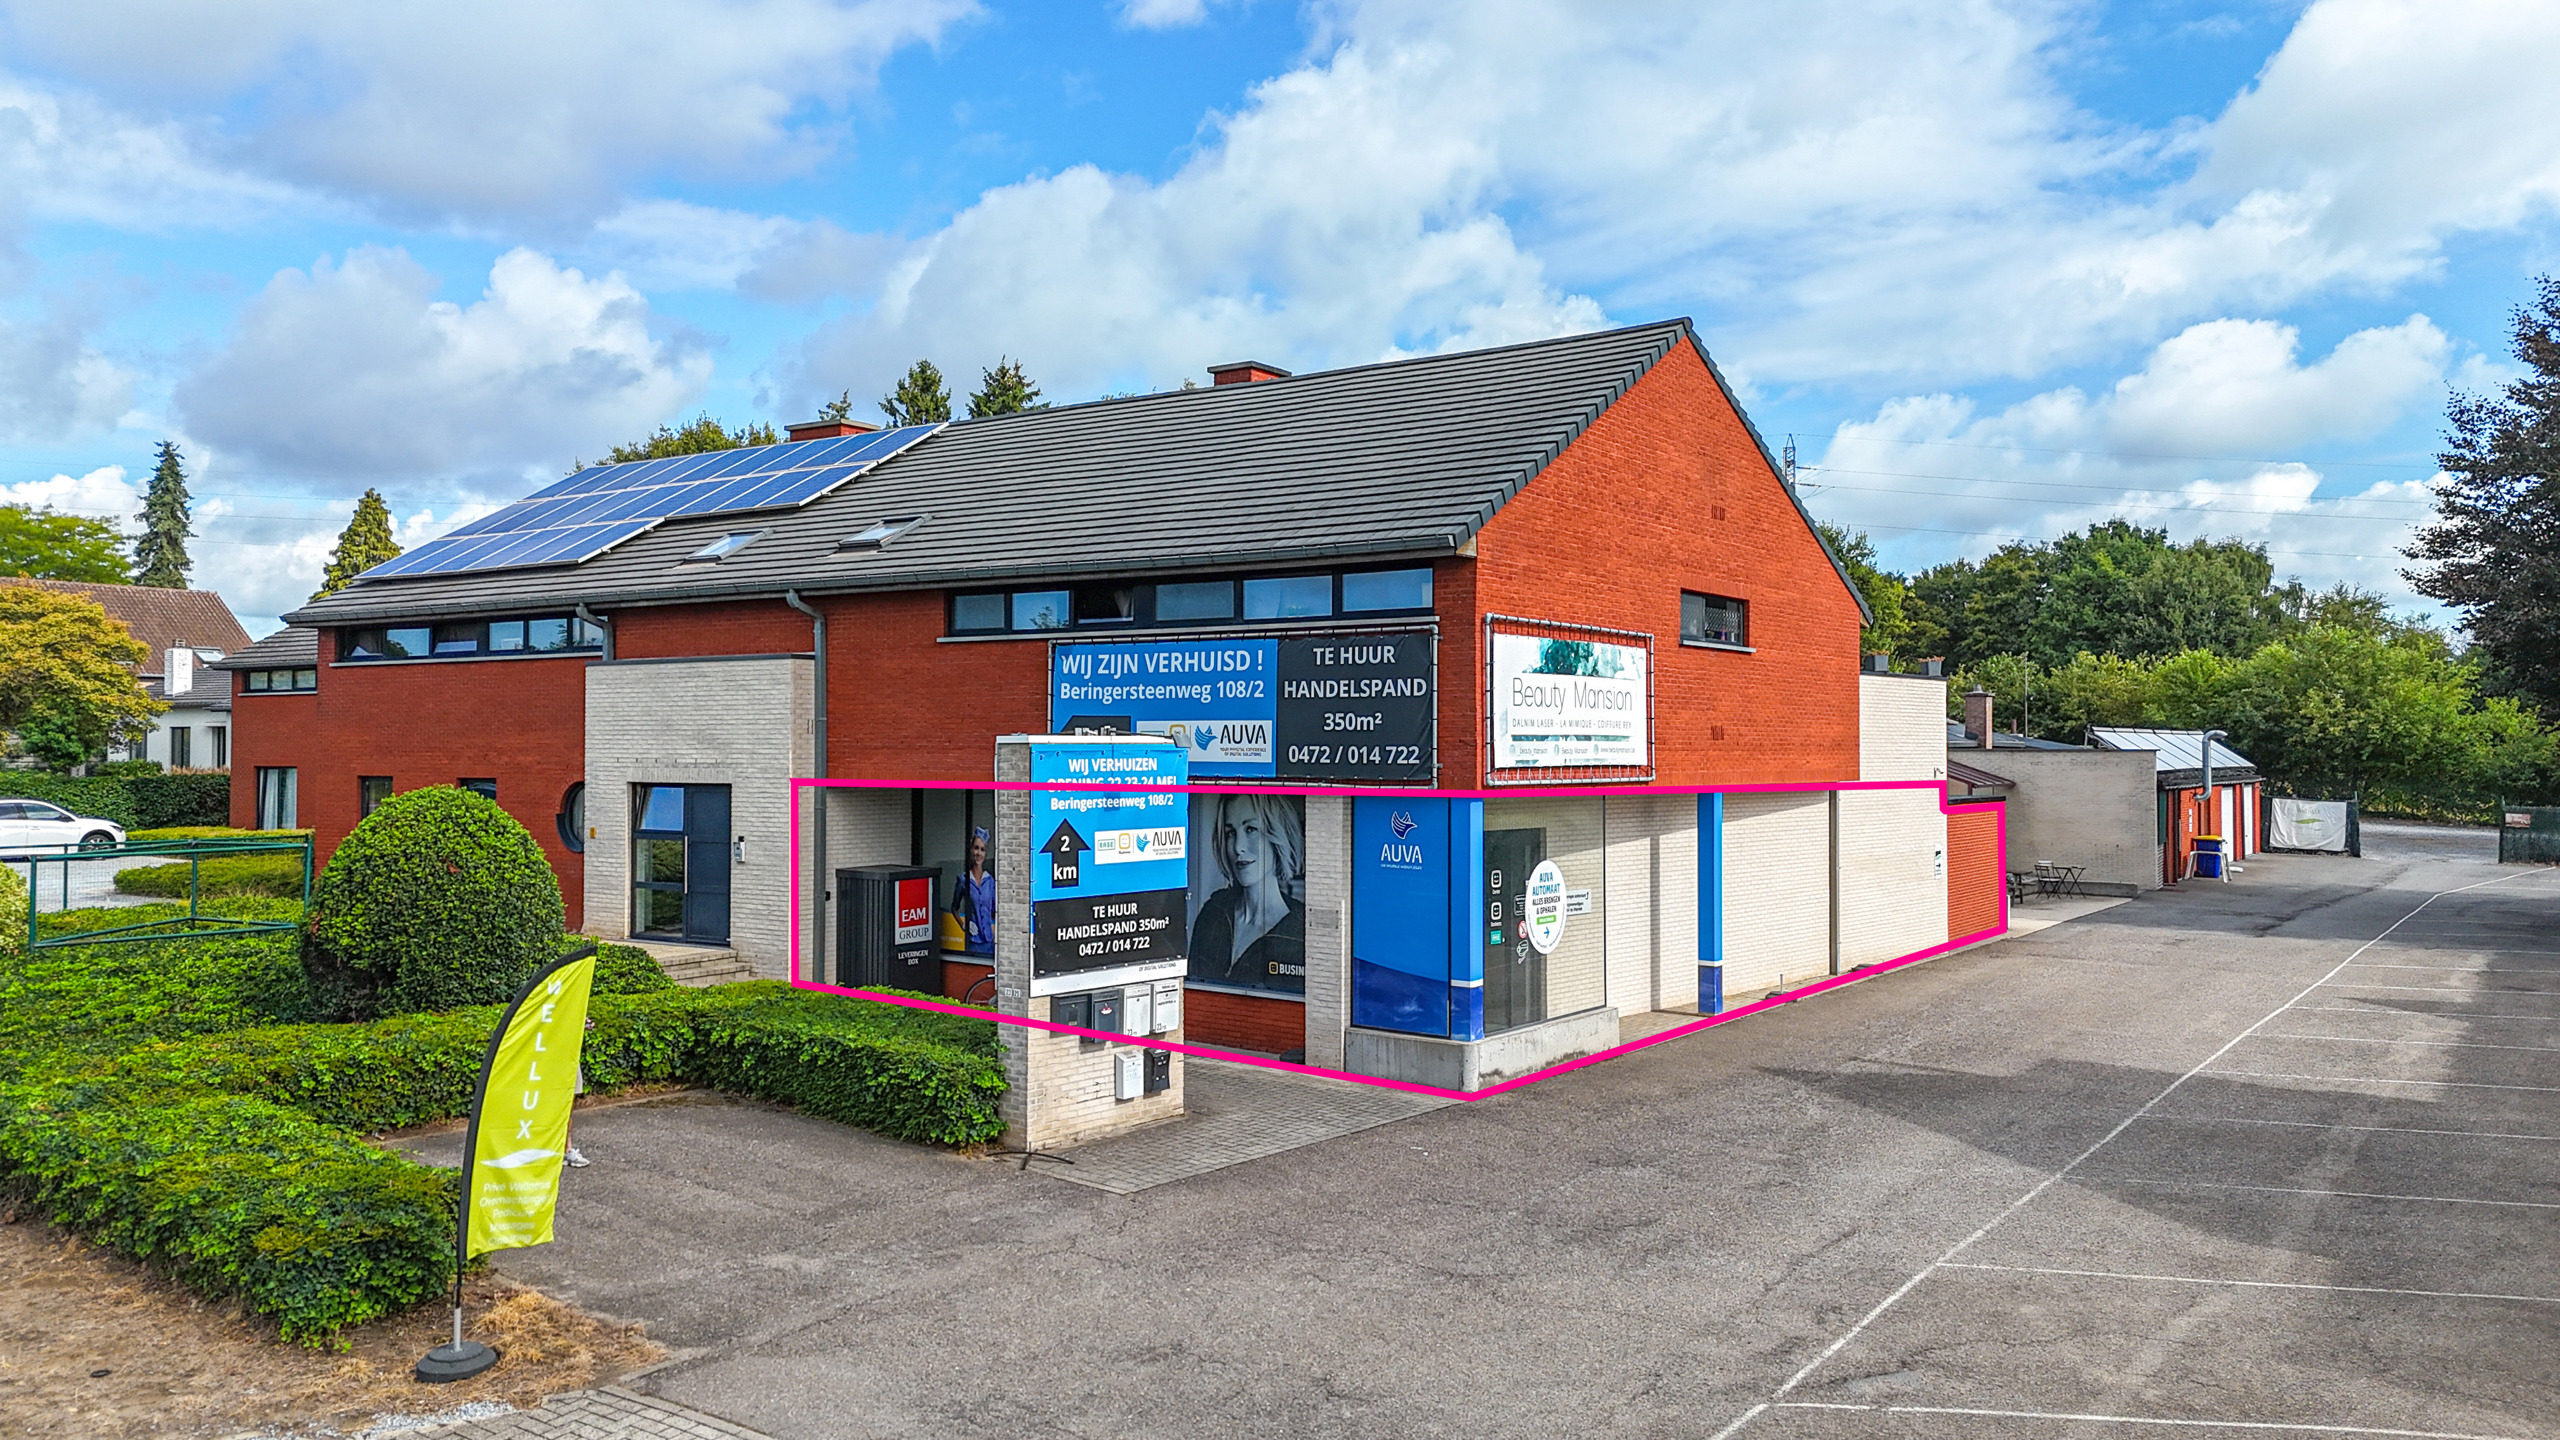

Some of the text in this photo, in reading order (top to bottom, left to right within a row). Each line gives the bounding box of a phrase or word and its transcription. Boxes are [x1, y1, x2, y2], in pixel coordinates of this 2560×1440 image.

[1313, 646, 1396, 665] TE HUUR
[1061, 650, 1263, 679] WIJ ZIJN VERHUISD !
[1060, 680, 1264, 705] Beringersteenweg 108/2
[1284, 678, 1427, 698] HANDELSPAND
[1512, 677, 1632, 715] Beauty Mansion
[1536, 718, 1554, 728] LASER
[1560, 719, 1567, 728] LA
[1568, 719, 1592, 728] MIMIQUE
[1597, 719, 1622, 729] COIFFURE
[1220, 724, 1267, 744] AUVA
[1288, 745, 1420, 764] 0472 / 014 722
[1068, 758, 1157, 775] WIJ VERHUIZEN
[1050, 794, 1174, 812] Beringersteenweg 108/2
[1060, 835, 1070, 851] 2
[1152, 830, 1182, 846] AUVA
[1381, 843, 1422, 864] AUVA
[1053, 863, 1077, 880] km
[1539, 872, 1554, 883] AUVA
[1532, 883, 1561, 896] AUTOMAAT
[1532, 897, 1544, 906] ALLES
[1543, 895, 1561, 905] BRENGEN
[902, 907, 926, 922] EAM
[1093, 903, 1138, 919] TE HUUR
[1540, 905, 1557, 914] OPHALEN
[899, 928, 929, 940] GROUP
[1057, 920, 1137, 940] HANDELSPAND
[898, 949, 929, 959] LEVERINGEN
[1079, 936, 1150, 956] 0472 / 014 722
[907, 958, 919, 966] BOX
